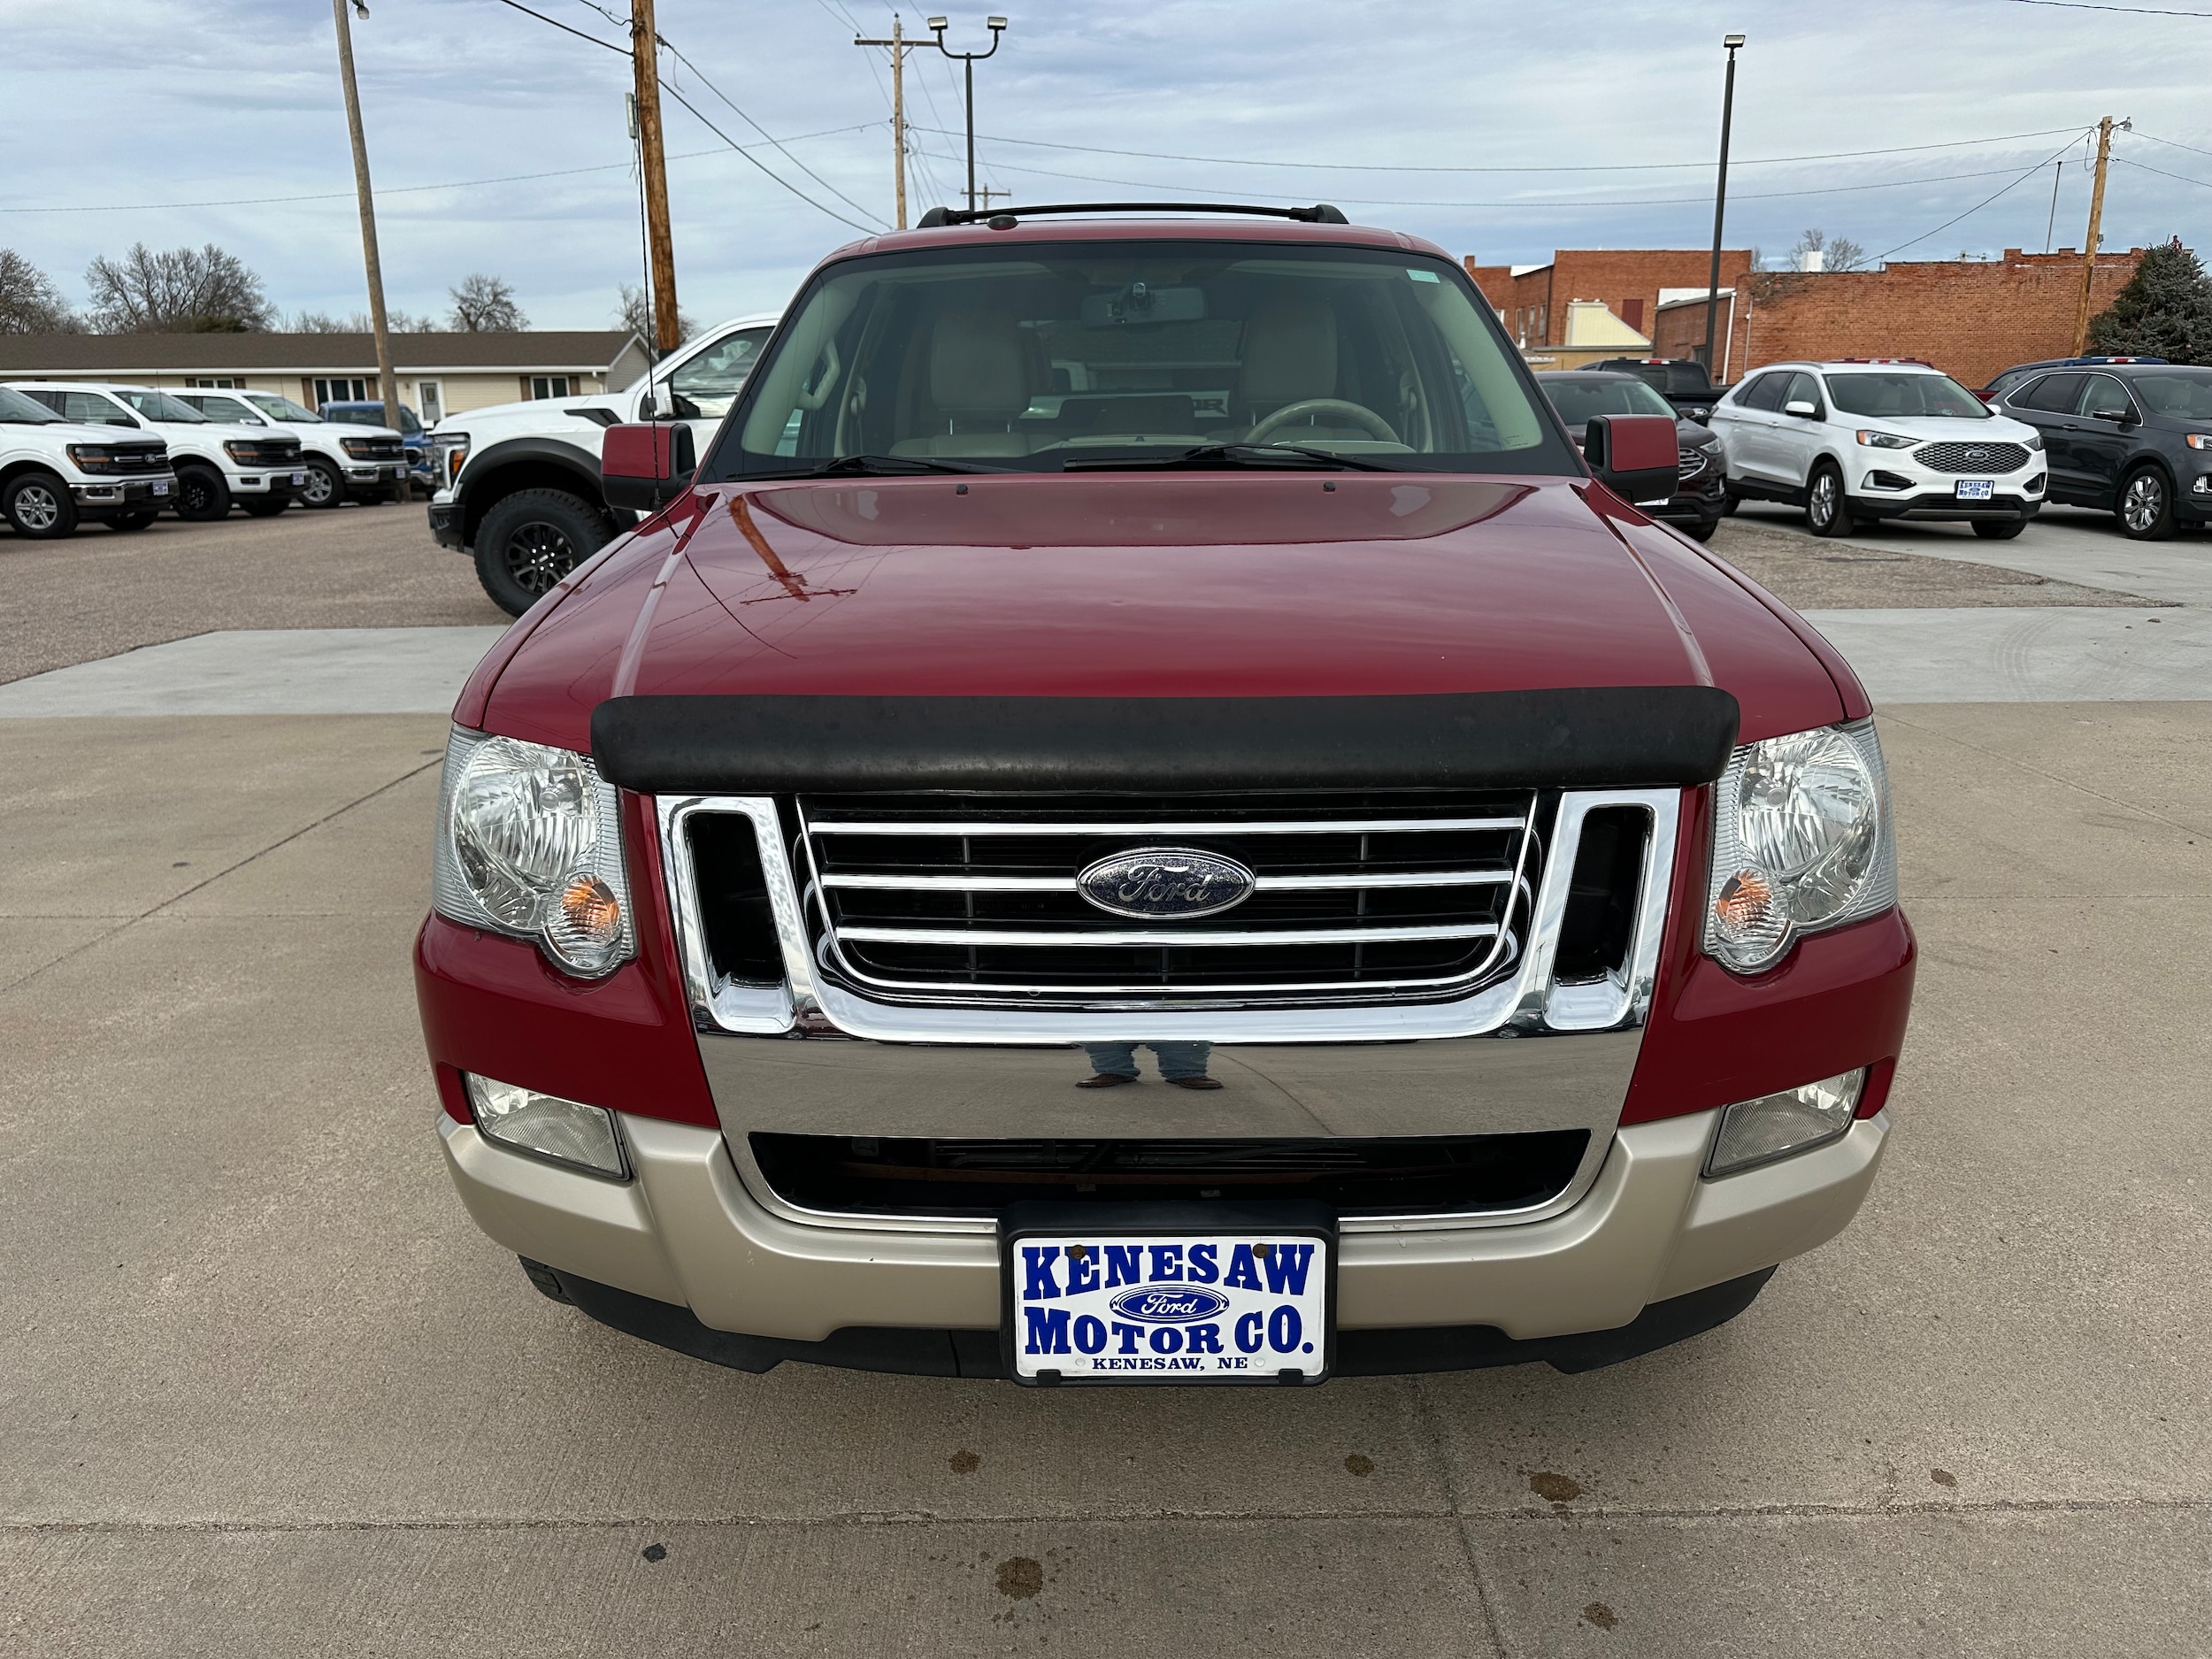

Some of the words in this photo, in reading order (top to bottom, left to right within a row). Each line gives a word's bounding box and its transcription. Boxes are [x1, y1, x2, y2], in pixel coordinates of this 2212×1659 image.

[1118, 864, 1213, 902] Ford
[1022, 1244, 1315, 1301] KENESAW
[1141, 1293, 1198, 1315] Ford
[1025, 1306, 1224, 1355] MOTOR
[1234, 1304, 1314, 1355] CO.
[1092, 1357, 1205, 1371] KENESAW,
[1217, 1357, 1248, 1369] NE
